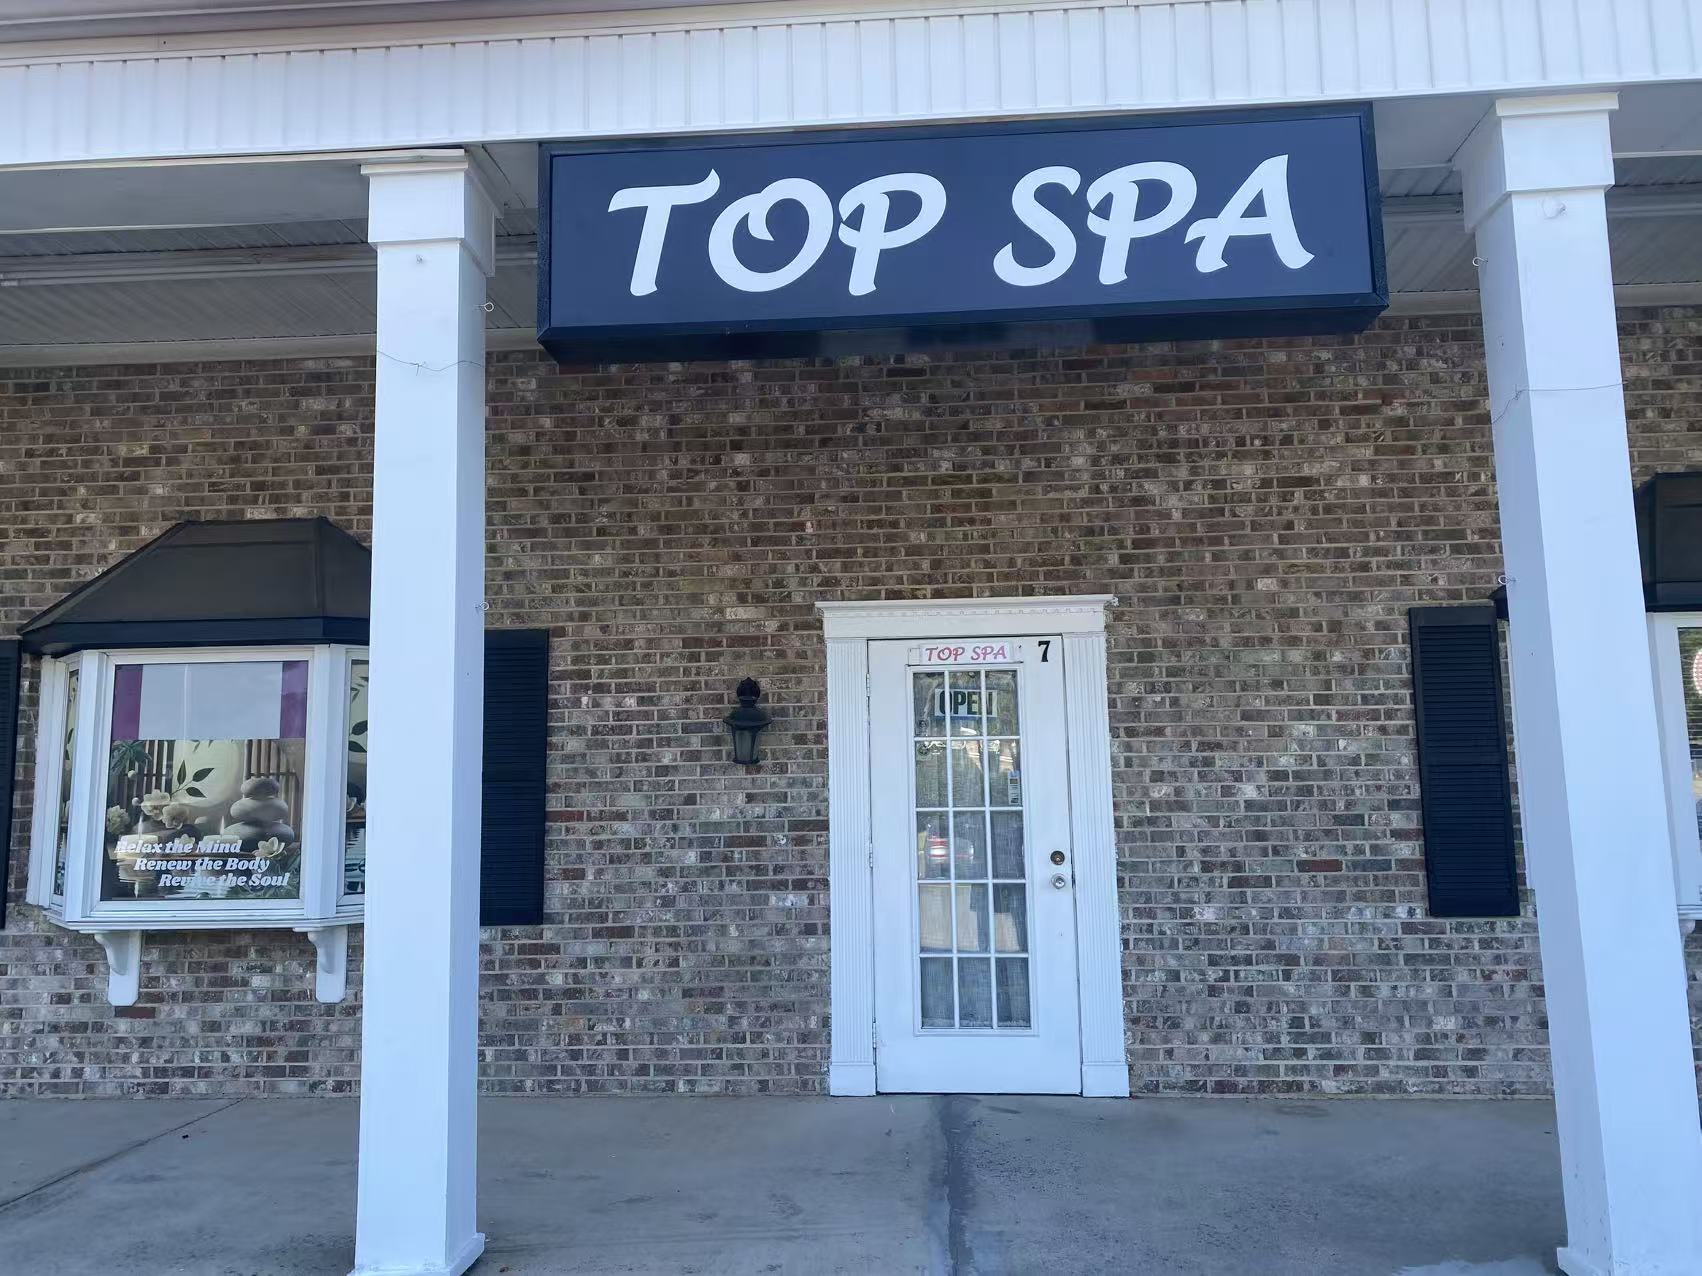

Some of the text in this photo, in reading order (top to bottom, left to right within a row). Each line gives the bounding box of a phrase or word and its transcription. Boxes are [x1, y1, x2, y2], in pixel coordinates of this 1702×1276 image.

[608, 153, 1316, 297] TOP SPA
[925, 645, 1007, 662] TOP SPA
[1038, 640, 1051, 663] 7
[939, 690, 993, 716] OPEN
[114, 838, 243, 854] Relax the Mind
[133, 857, 270, 873] Renew the Body
[158, 872, 290, 887] Reve the Soul
